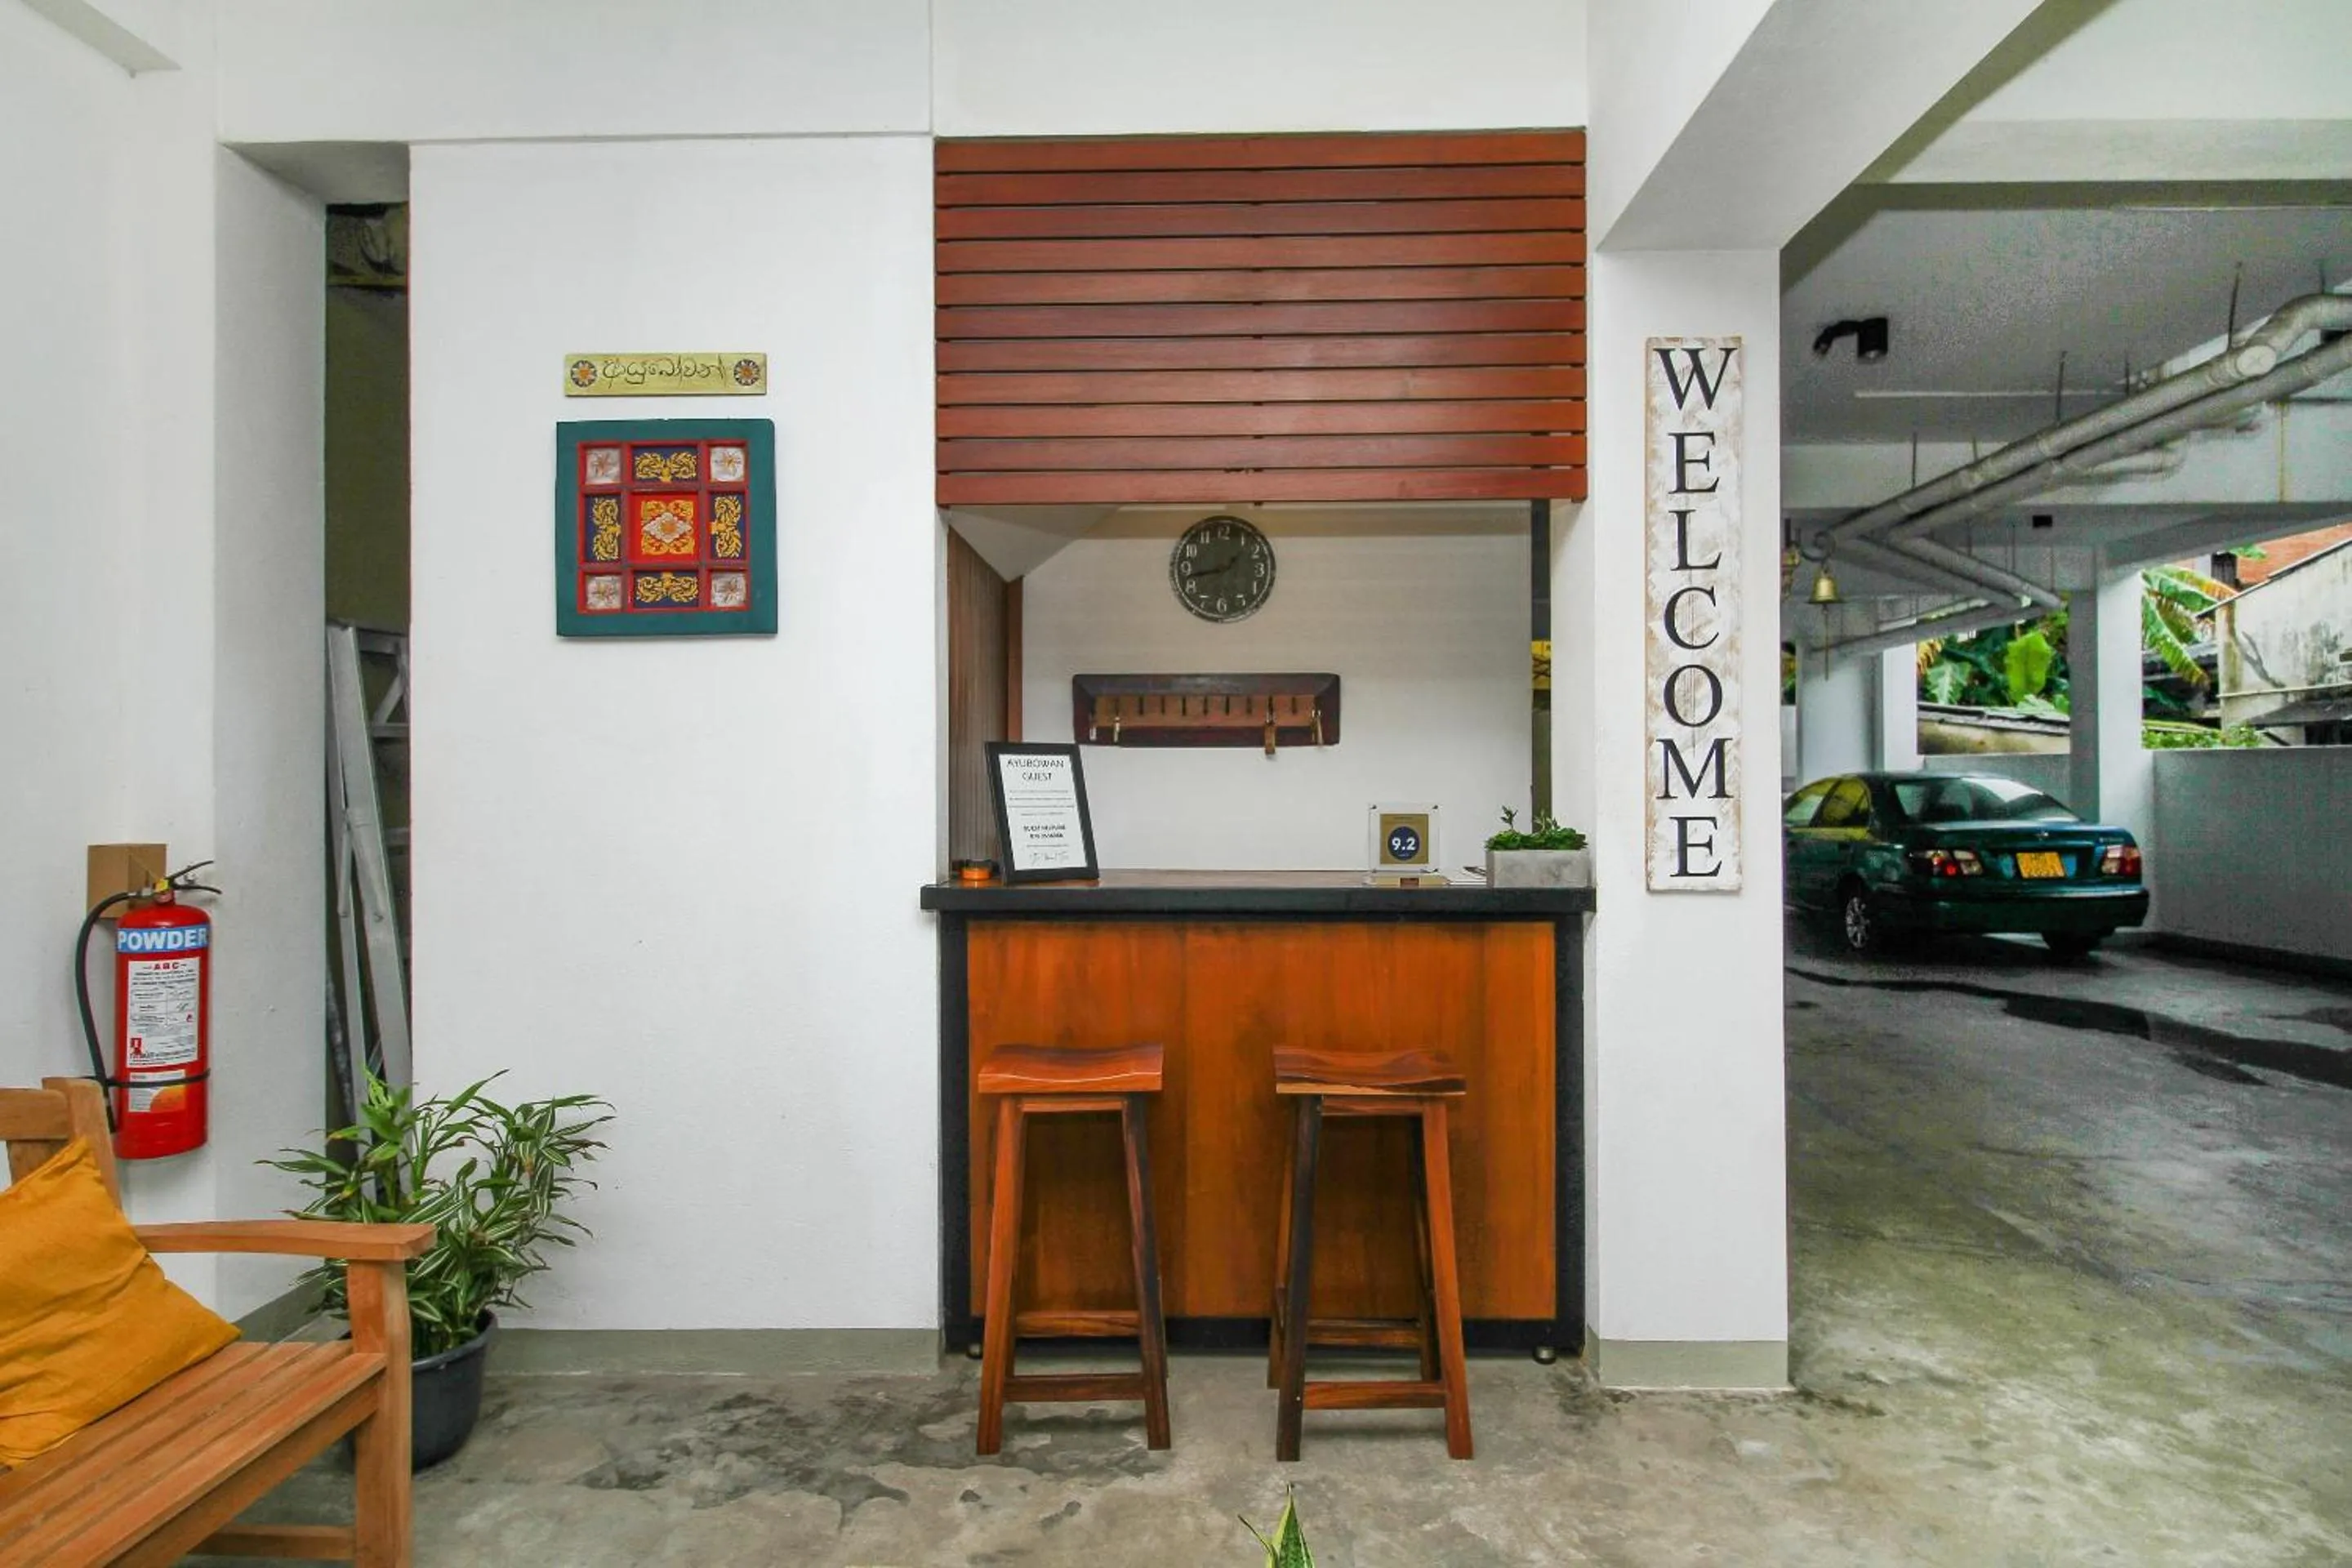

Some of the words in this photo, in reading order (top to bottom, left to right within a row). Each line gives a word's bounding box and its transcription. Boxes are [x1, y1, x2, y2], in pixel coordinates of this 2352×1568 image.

[1200, 530, 1210, 544] 11
[1186, 544, 1197, 558] 10
[1250, 543, 1260, 559] 2
[1180, 560, 1192, 576] 9
[1254, 562, 1265, 577] 3
[1186, 579, 1197, 593] 8
[1216, 597, 1227, 613] 6
[1653, 346, 1737, 878] WELCOME
[1392, 836, 1416, 851] 9.2
[117, 928, 207, 951] POWDER
